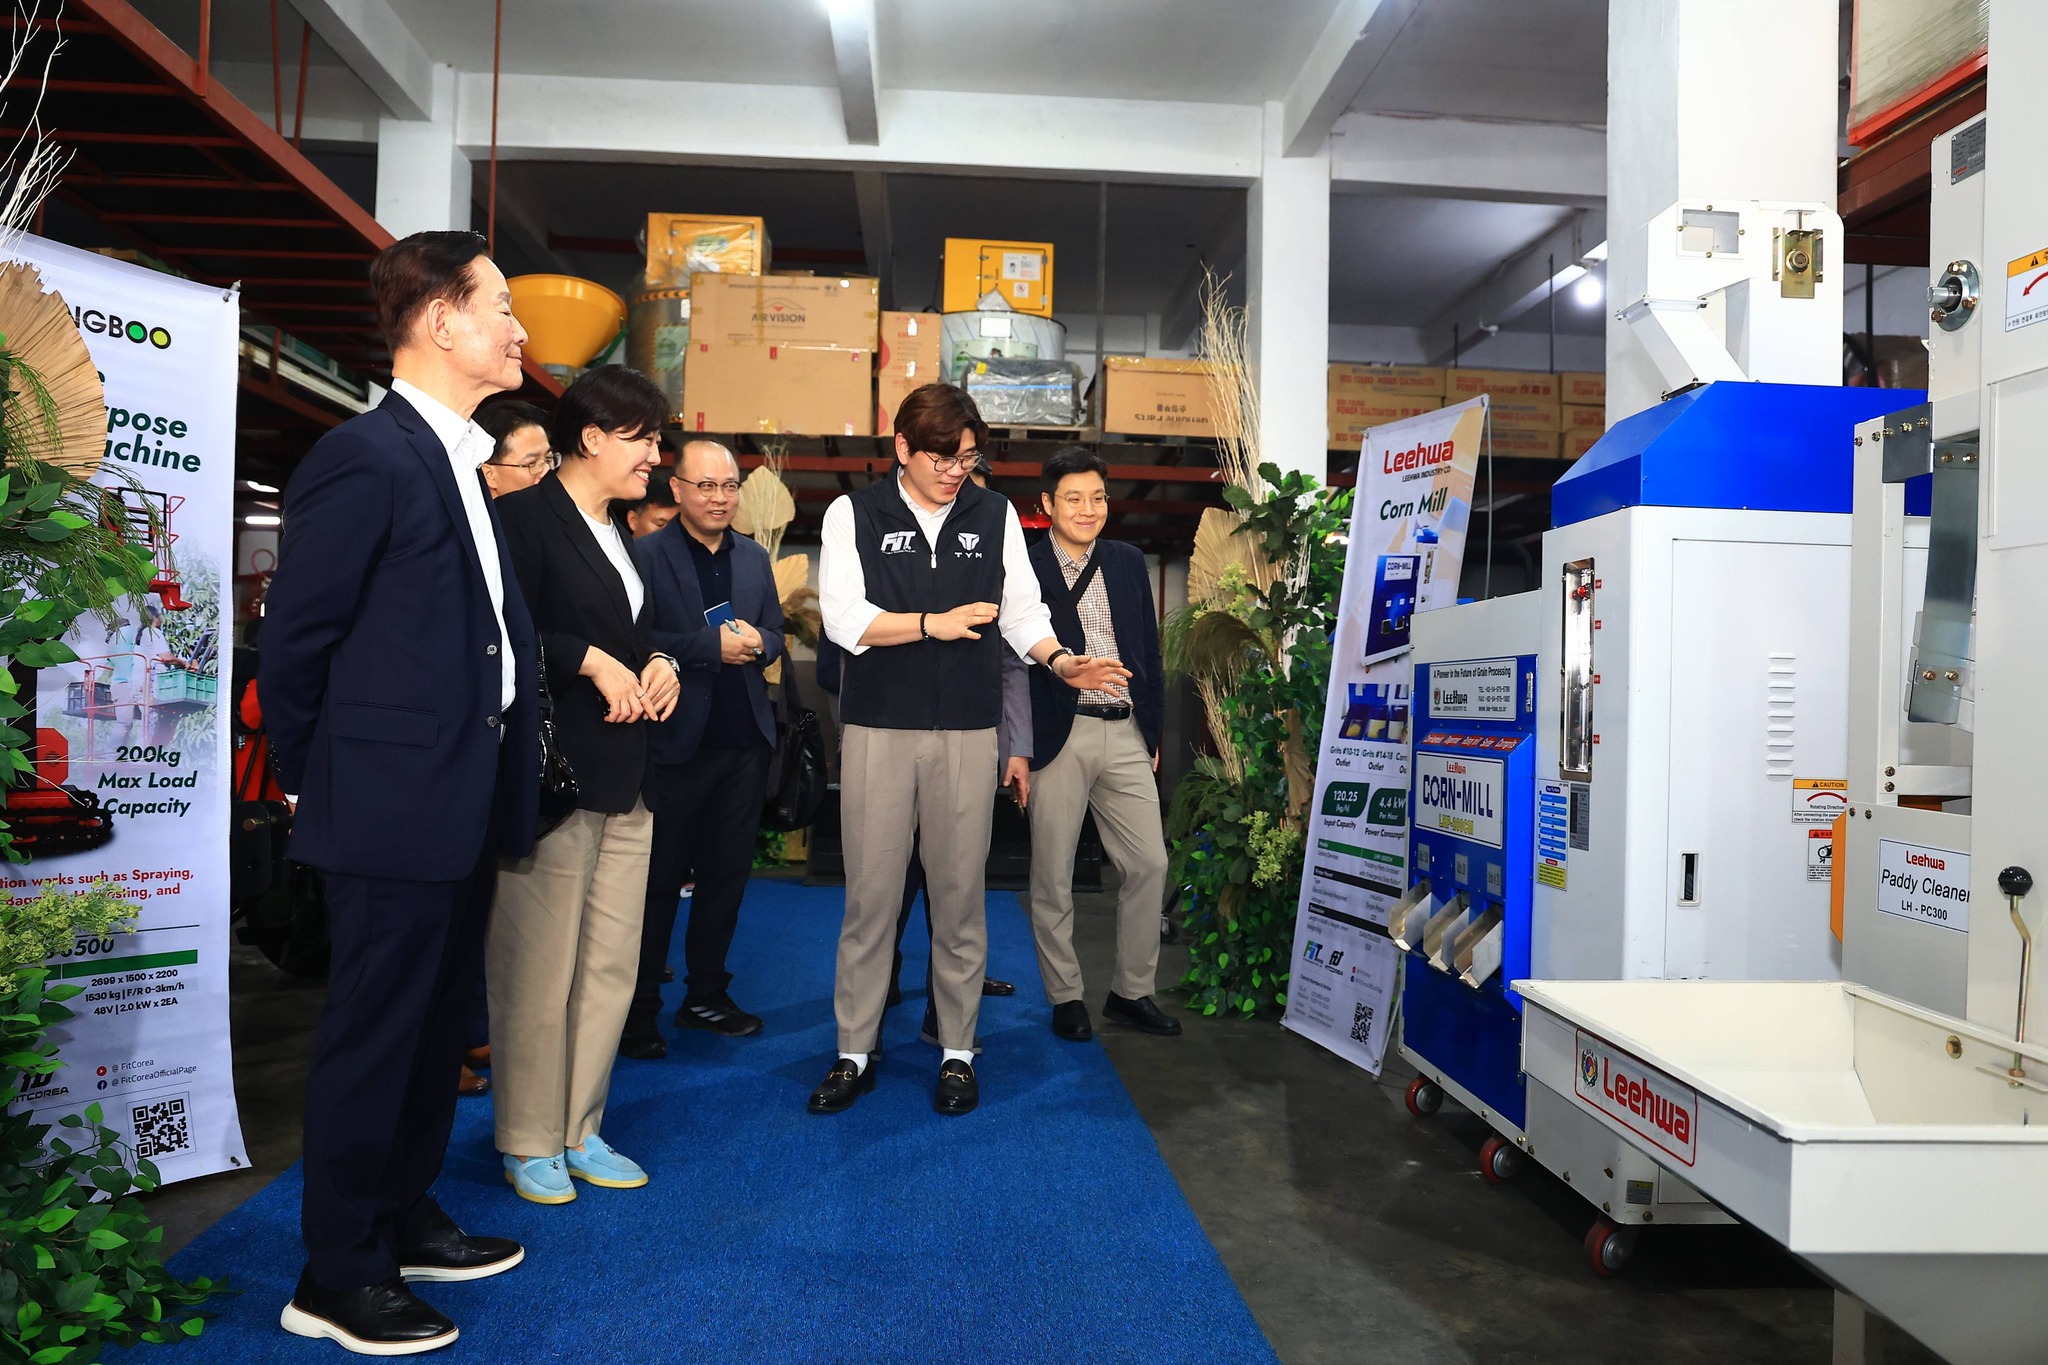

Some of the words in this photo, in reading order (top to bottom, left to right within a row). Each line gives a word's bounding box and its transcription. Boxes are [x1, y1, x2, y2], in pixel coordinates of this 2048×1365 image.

[106, 406, 188, 438] pose
[104, 434, 201, 472] chine
[1384, 440, 1454, 475] Leehwa
[1380, 499, 1414, 521] Corn
[1417, 487, 1448, 514] Mill
[1460, 668, 1472, 678] Future
[1477, 667, 1488, 677] Grain
[1488, 666, 1511, 678] Processing
[115, 744, 181, 767] 200kg
[1330, 746, 1342, 755] Grits
[1362, 749, 1374, 758] Grits
[1335, 758, 1351, 767] Outlet
[1368, 761, 1384, 771] Outlet
[97, 771, 142, 789] Max
[148, 770, 198, 788] Load
[1333, 790, 1358, 802] 120.25
[1379, 797, 1392, 808] 4.4
[1423, 774, 1493, 818] CORN-MILL
[104, 797, 191, 818] Capacity
[1324, 818, 1336, 828] Input
[1336, 819, 1357, 830] Capacity
[1365, 827, 1380, 837] Power
[1905, 850, 1945, 871] Leehwa
[0, 877, 26, 889] tion
[78, 870, 109, 884] such
[113, 873, 128, 882] as
[132, 867, 194, 882] Spraying,
[1881, 868, 1918, 895] Paddy
[156, 883, 180, 896] and
[1901, 900, 1913, 912] LH
[1920, 904, 1948, 920] PC300
[91, 976, 116, 987] 2699
[125, 973, 146, 983] 1500
[155, 969, 178, 979] 2200
[85, 992, 107, 1002] 1530
[109, 990, 121, 1000] kg
[127, 987, 143, 997] F/R
[145, 981, 185, 994] 0-3km/h
[94, 1005, 113, 1016] 48V
[120, 1002, 134, 1012] 2.0
[136, 1000, 151, 1010] kW
[161, 997, 178, 1007] 2EA
[121, 1059, 154, 1071] FitCorea
[121, 1065, 197, 1085] FitCoreaOfficialPage
[10, 1086, 69, 1103] ITCOREA
[1603, 1056, 1690, 1145] Leehwa
